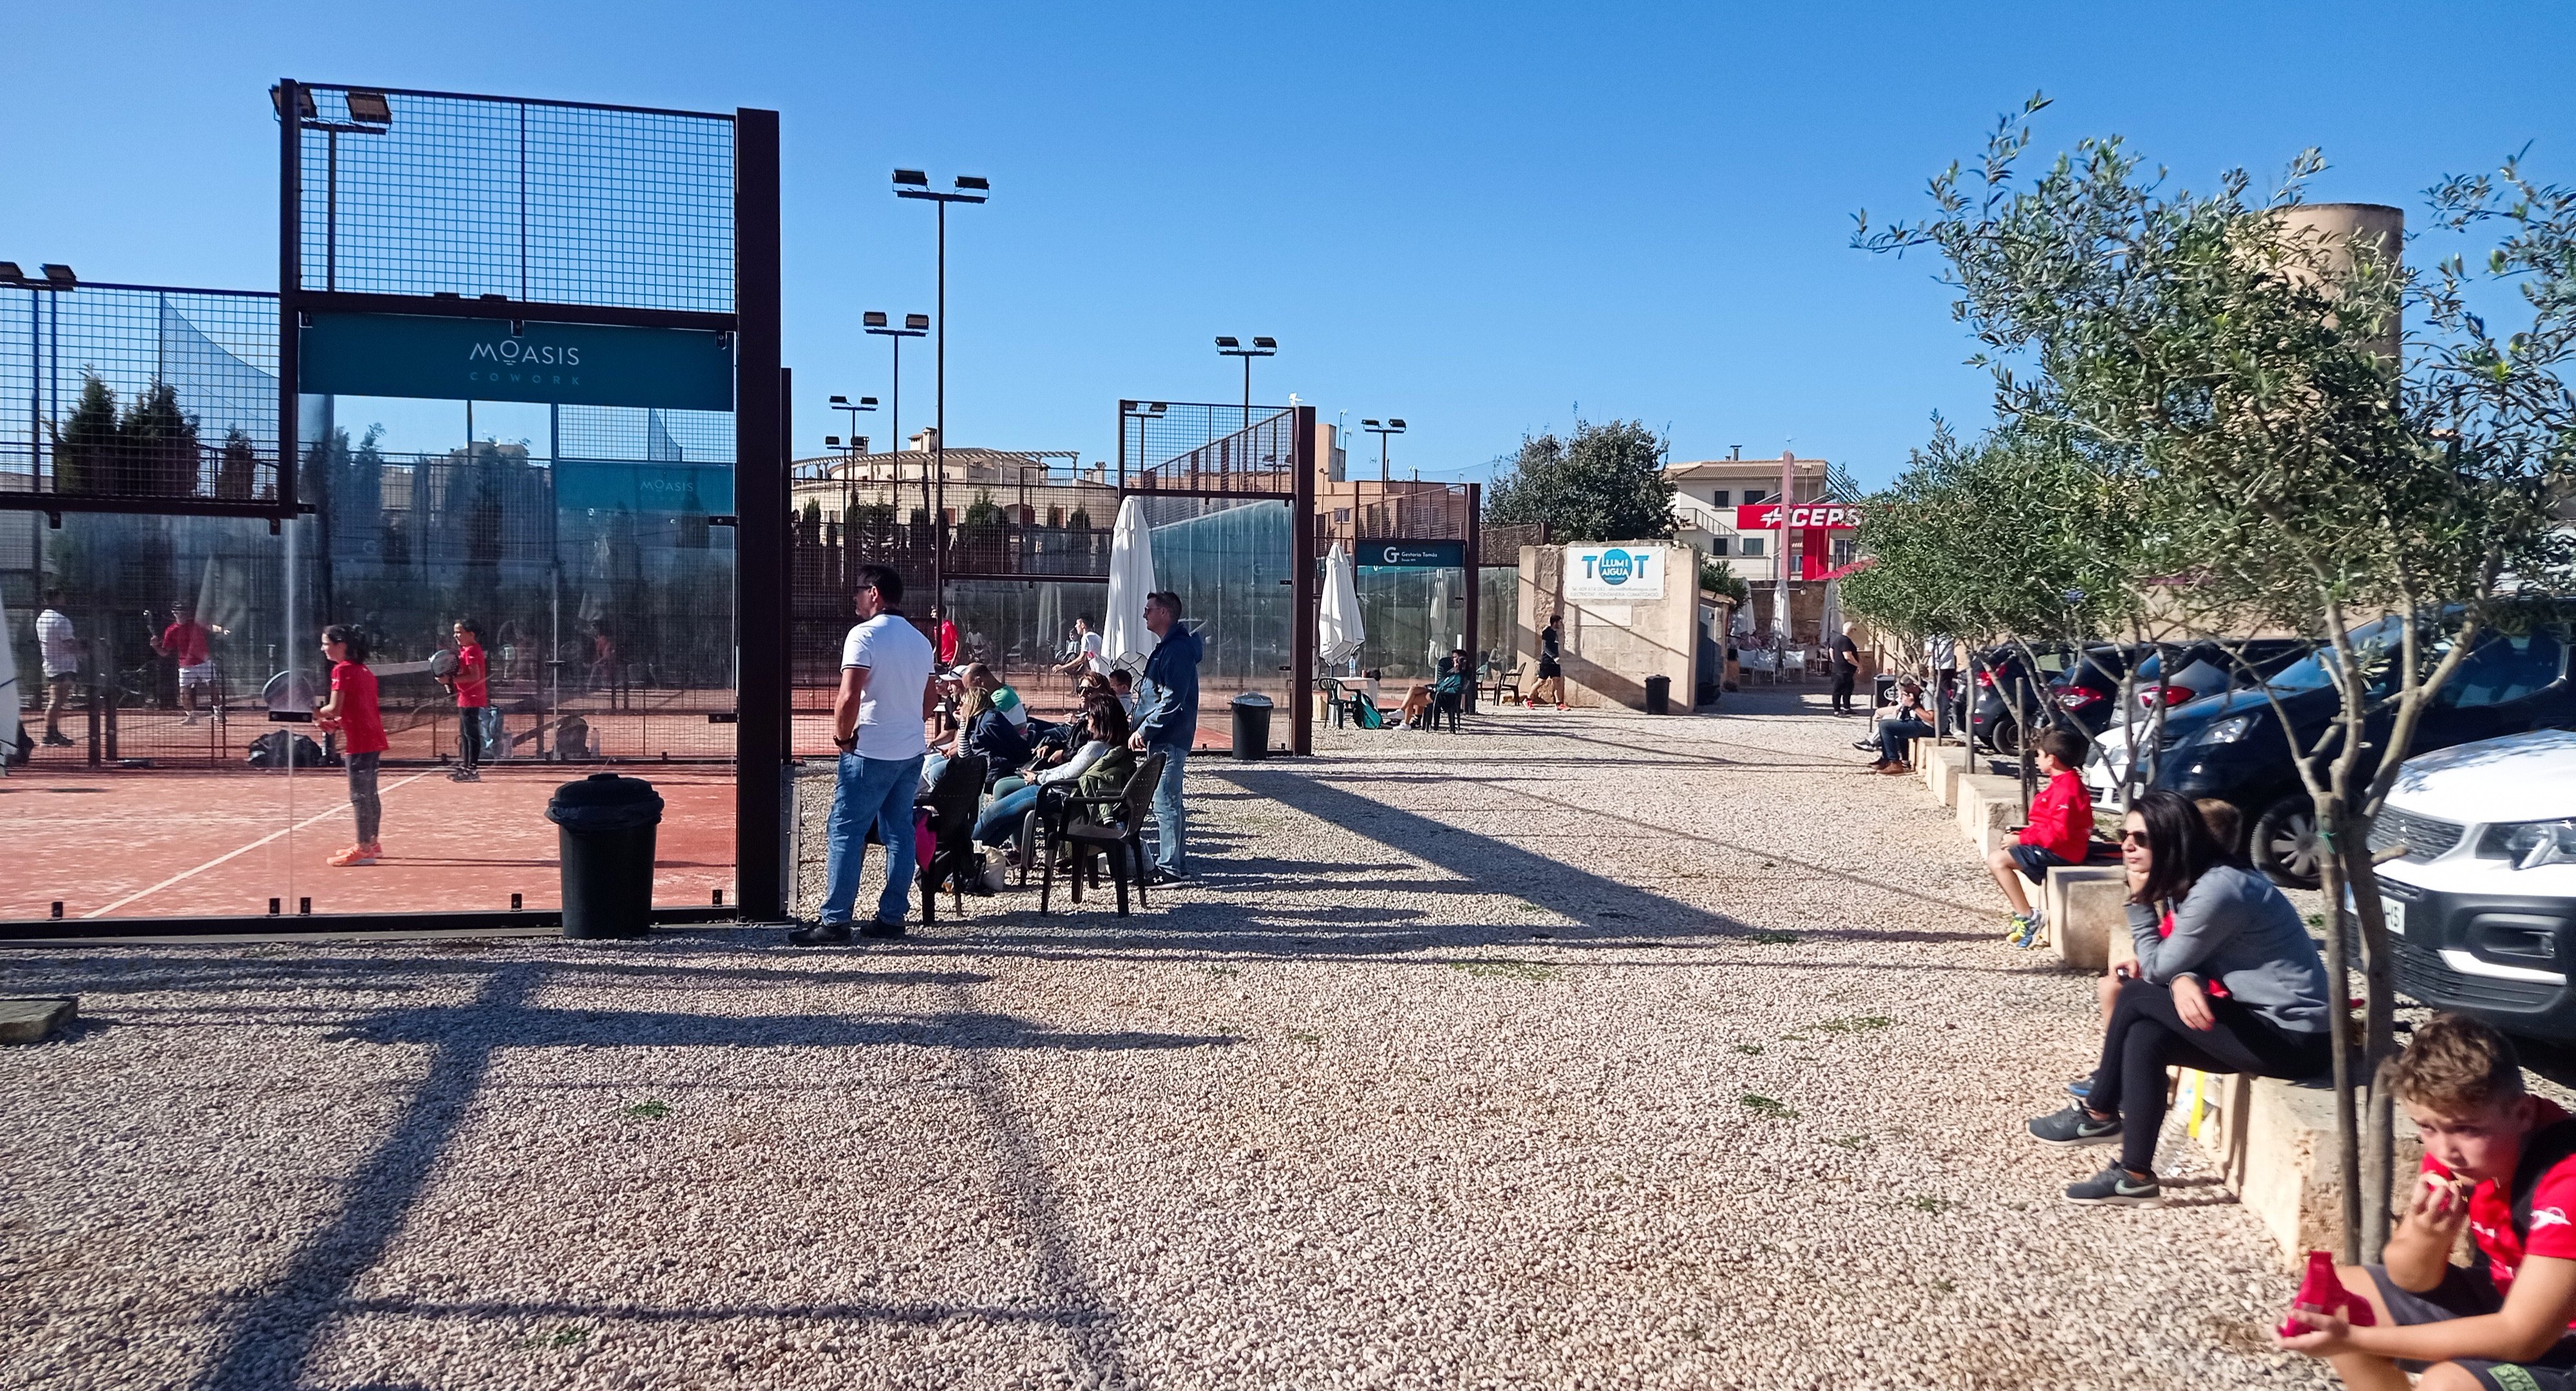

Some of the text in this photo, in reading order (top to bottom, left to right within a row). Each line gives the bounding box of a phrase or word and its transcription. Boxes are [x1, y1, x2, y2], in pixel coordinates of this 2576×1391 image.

[469, 340, 580, 365] MOASIS
[469, 372, 579, 385] COWORK
[640, 480, 694, 492] MOASIS
[1792, 508, 1861, 527] CEPS
[1602, 568, 1630, 579] AIGUA
